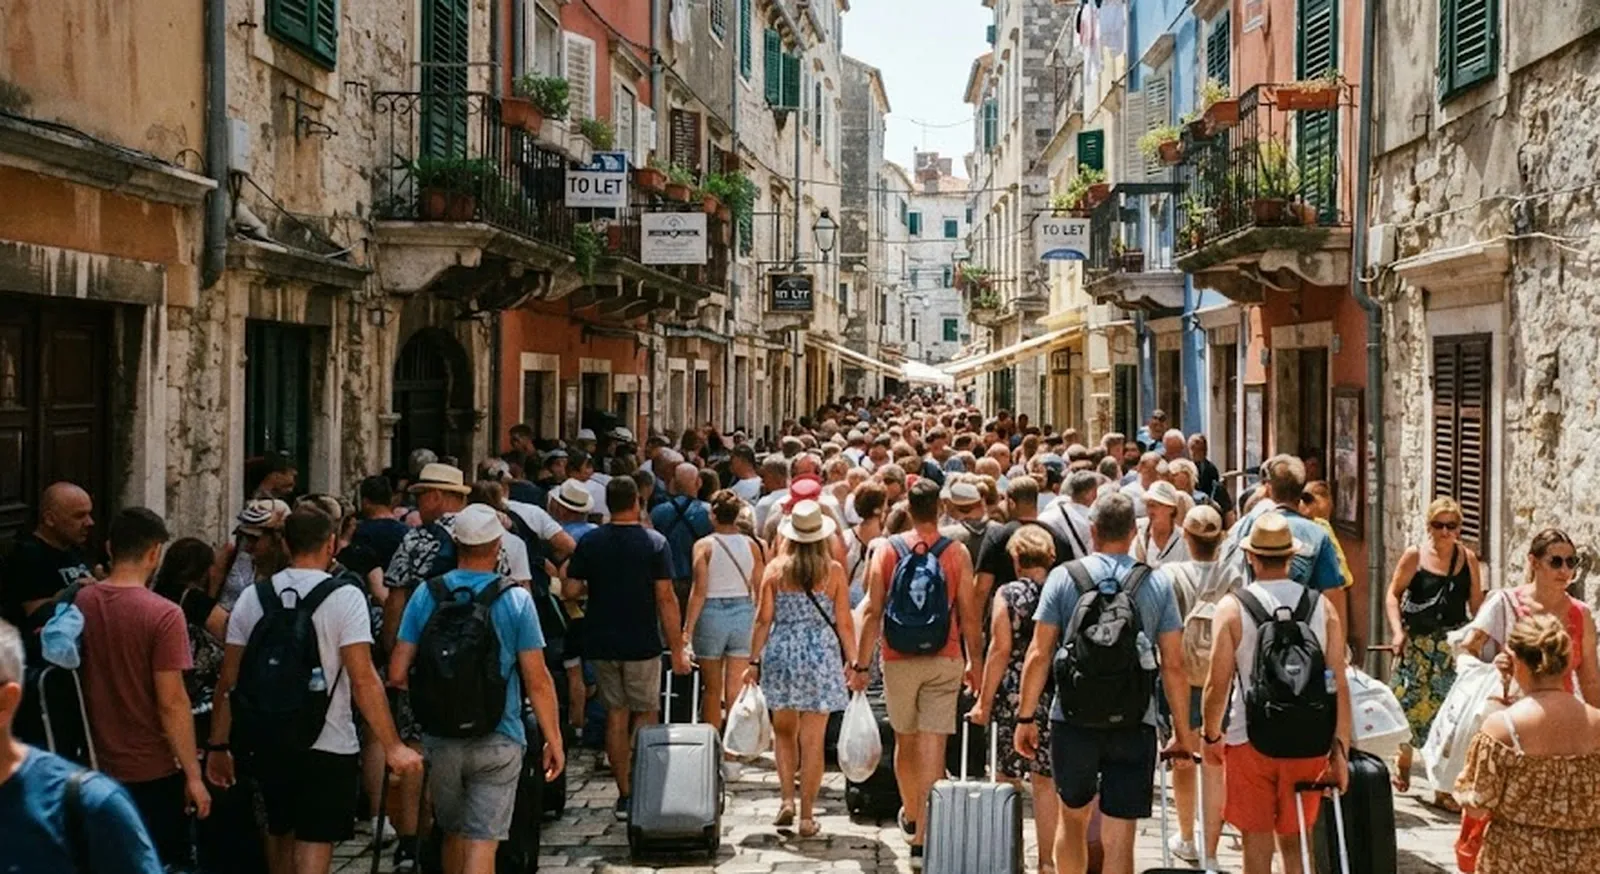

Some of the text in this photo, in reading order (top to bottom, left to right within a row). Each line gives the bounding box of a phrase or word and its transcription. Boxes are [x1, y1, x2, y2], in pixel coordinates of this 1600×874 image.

[568, 176, 622, 195] TO LET
[1043, 224, 1085, 235] TO LET
